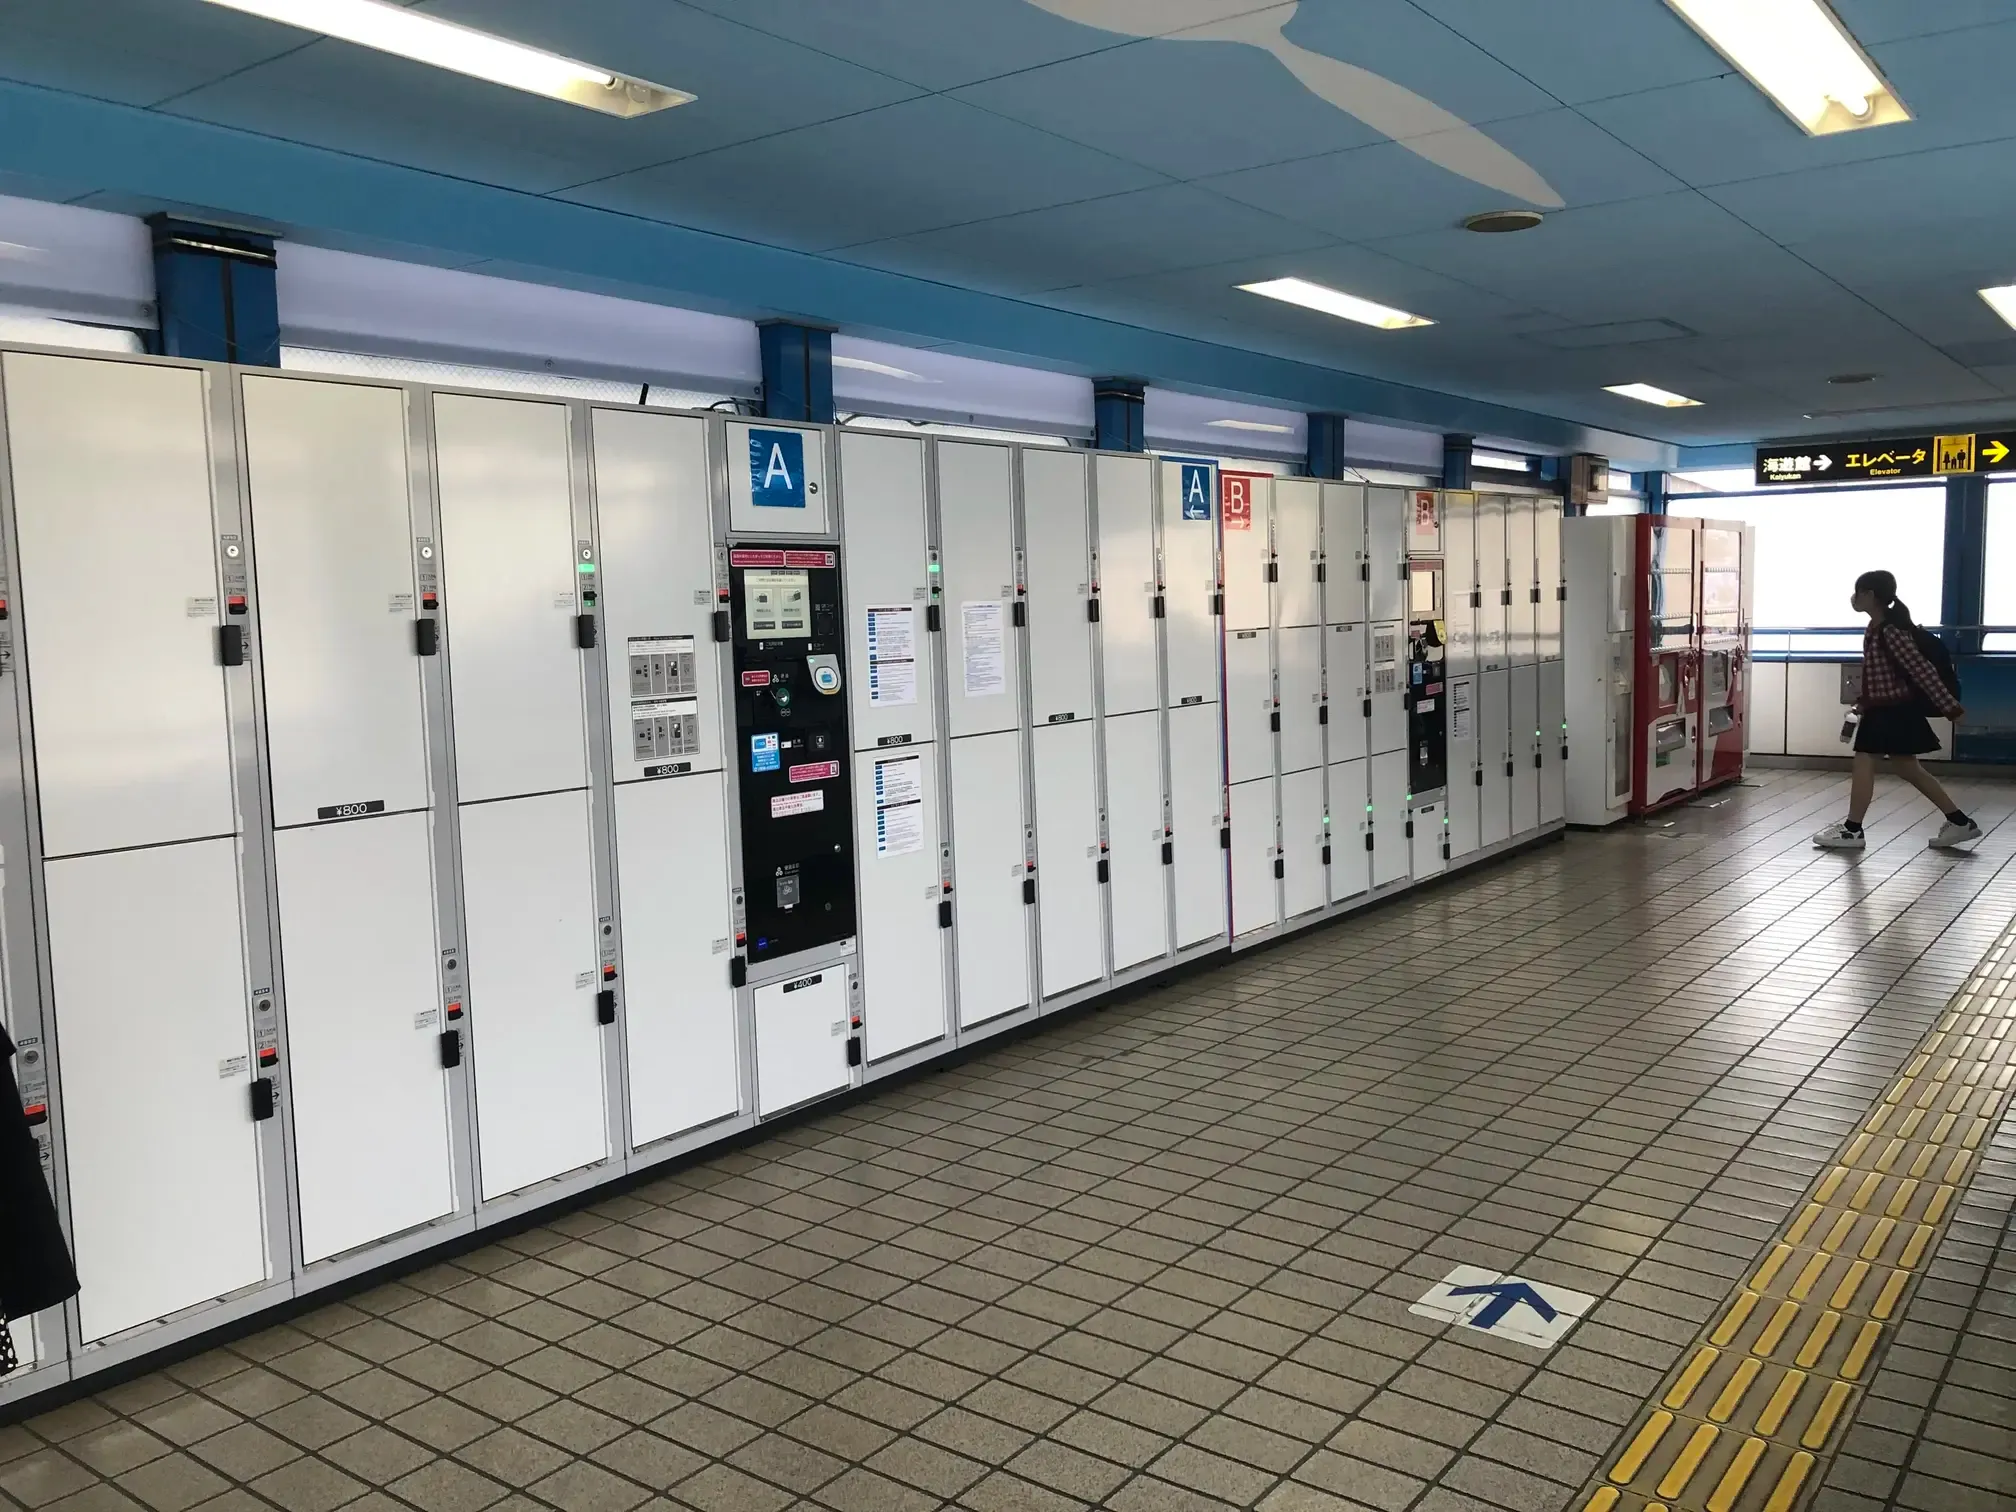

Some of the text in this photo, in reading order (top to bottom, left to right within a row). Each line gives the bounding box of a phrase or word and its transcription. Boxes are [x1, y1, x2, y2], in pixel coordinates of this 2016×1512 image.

[763, 442, 793, 490] A
[1845, 448, 1927, 468] エレベータ
[1869, 467, 1902, 476] Elevator
[1188, 469, 1205, 503] A
[1230, 481, 1244, 514] B
[1420, 499, 1430, 526] B
[886, 735, 903, 744] ¥800
[656, 764, 679, 775] ¥800
[335, 803, 368, 816] ¥800
[793, 977, 812, 989] ¥400
